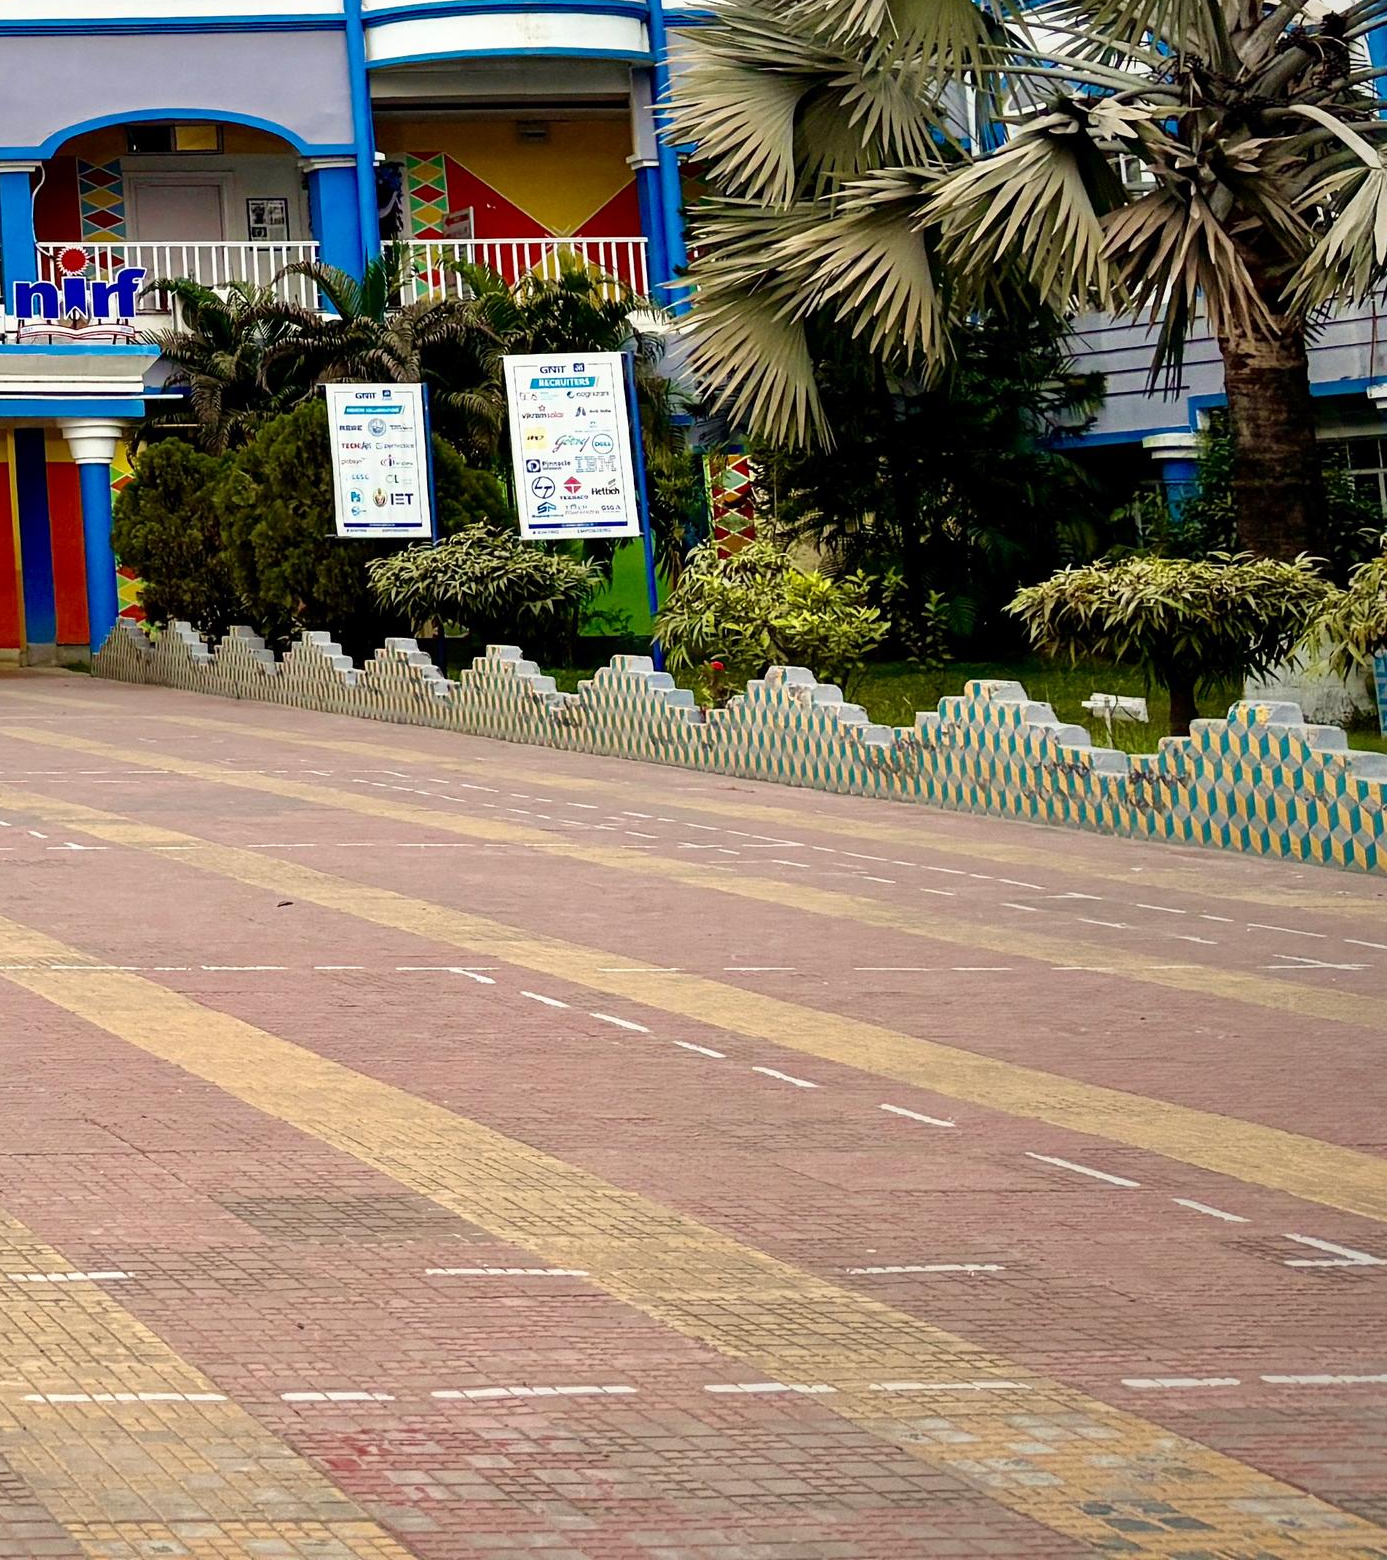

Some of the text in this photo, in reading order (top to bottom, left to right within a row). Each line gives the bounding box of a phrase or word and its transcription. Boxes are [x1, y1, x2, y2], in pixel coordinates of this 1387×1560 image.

[13, 248, 148, 320] nirf
[539, 365, 567, 374] GNIT
[538, 377, 590, 387] RECRUITERS
[575, 454, 617, 473] IBM
[390, 493, 414, 505] IET
